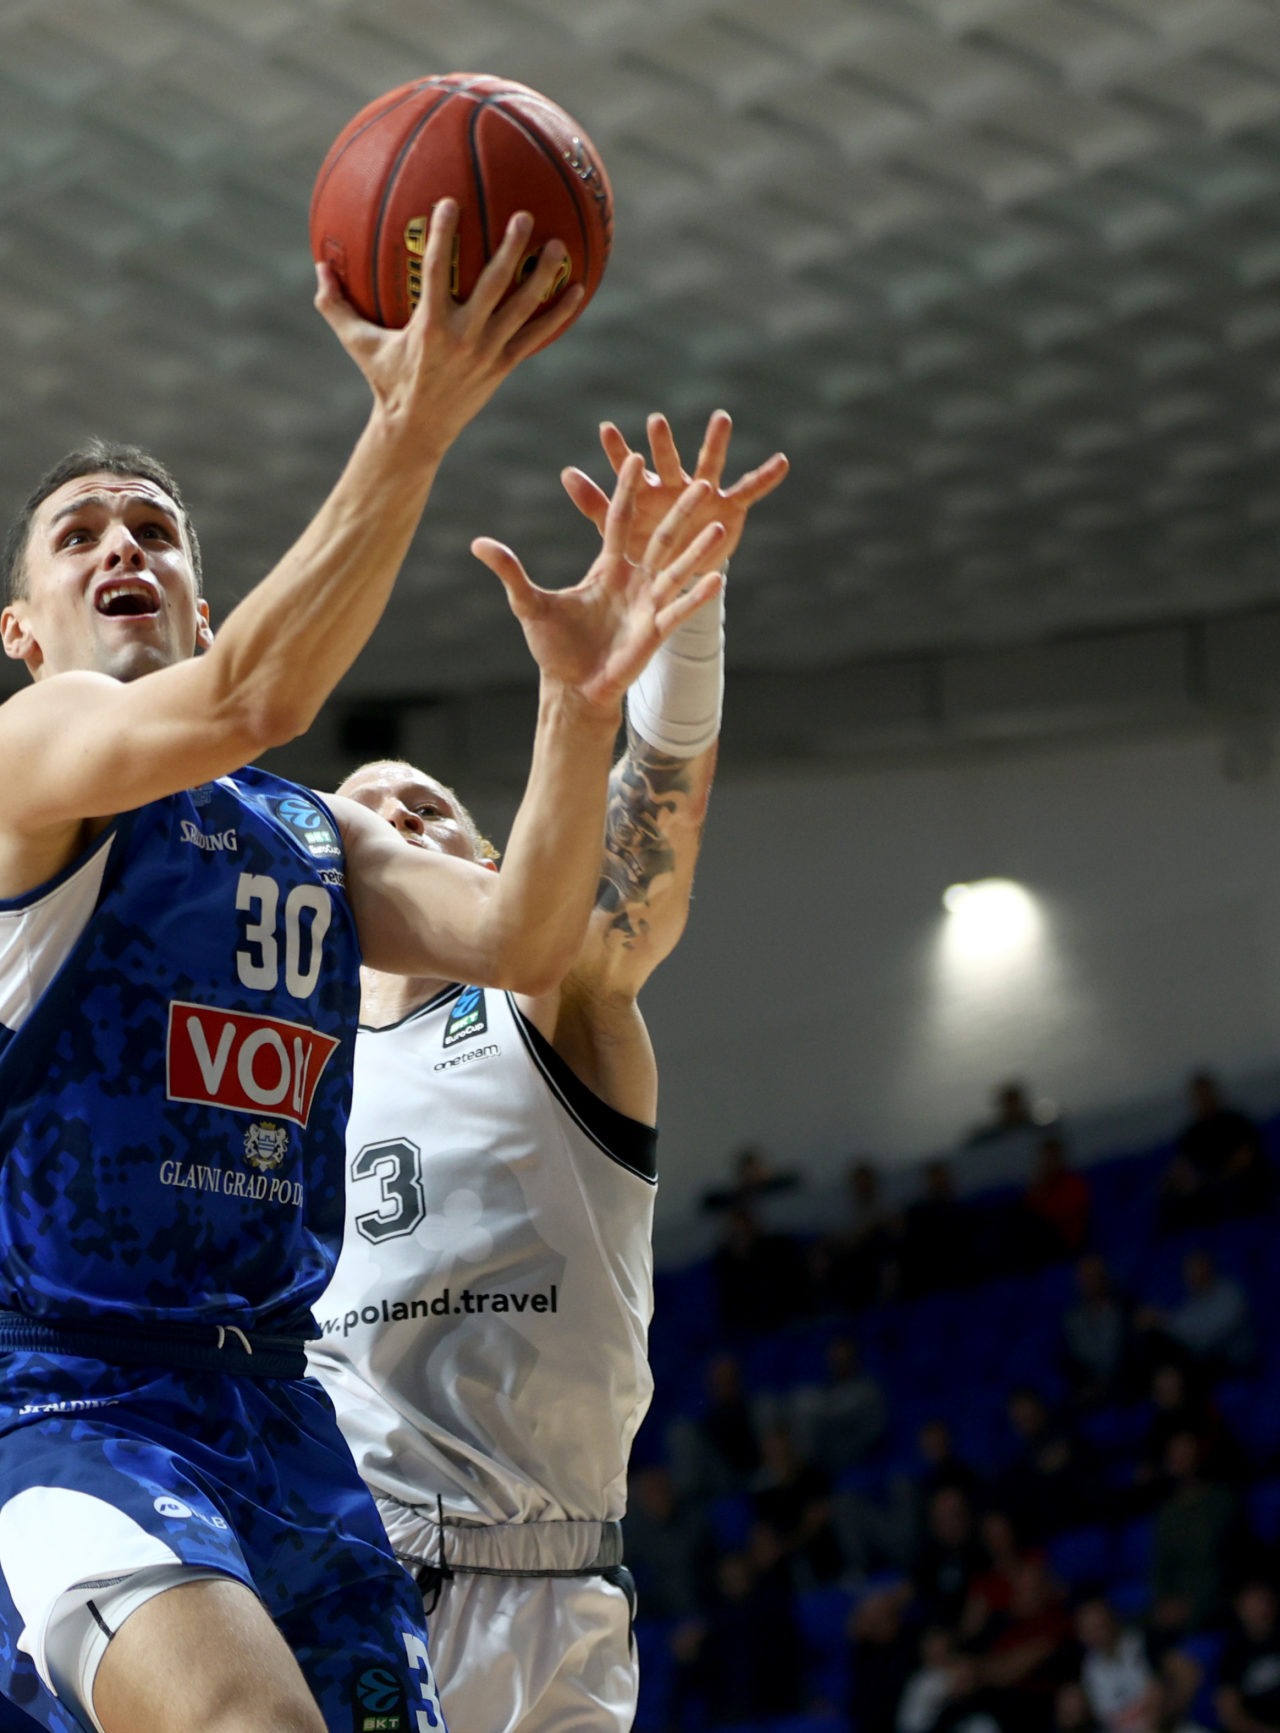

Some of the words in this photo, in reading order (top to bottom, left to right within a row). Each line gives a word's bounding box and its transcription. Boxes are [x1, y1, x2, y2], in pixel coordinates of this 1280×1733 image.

[179, 819, 237, 851] SPDING
[235, 872, 332, 999] 30
[444, 1022, 485, 1045] EuroCup
[186, 1015, 313, 1116] VOL
[433, 1044, 500, 1071] oneteam
[159, 1160, 222, 1193] GLAVNI
[223, 1170, 268, 1200] GRAD
[350, 1136, 427, 1246] 3
[19, 1399, 121, 1415] SPALDI
[363, 1717, 400, 1731] BKT
